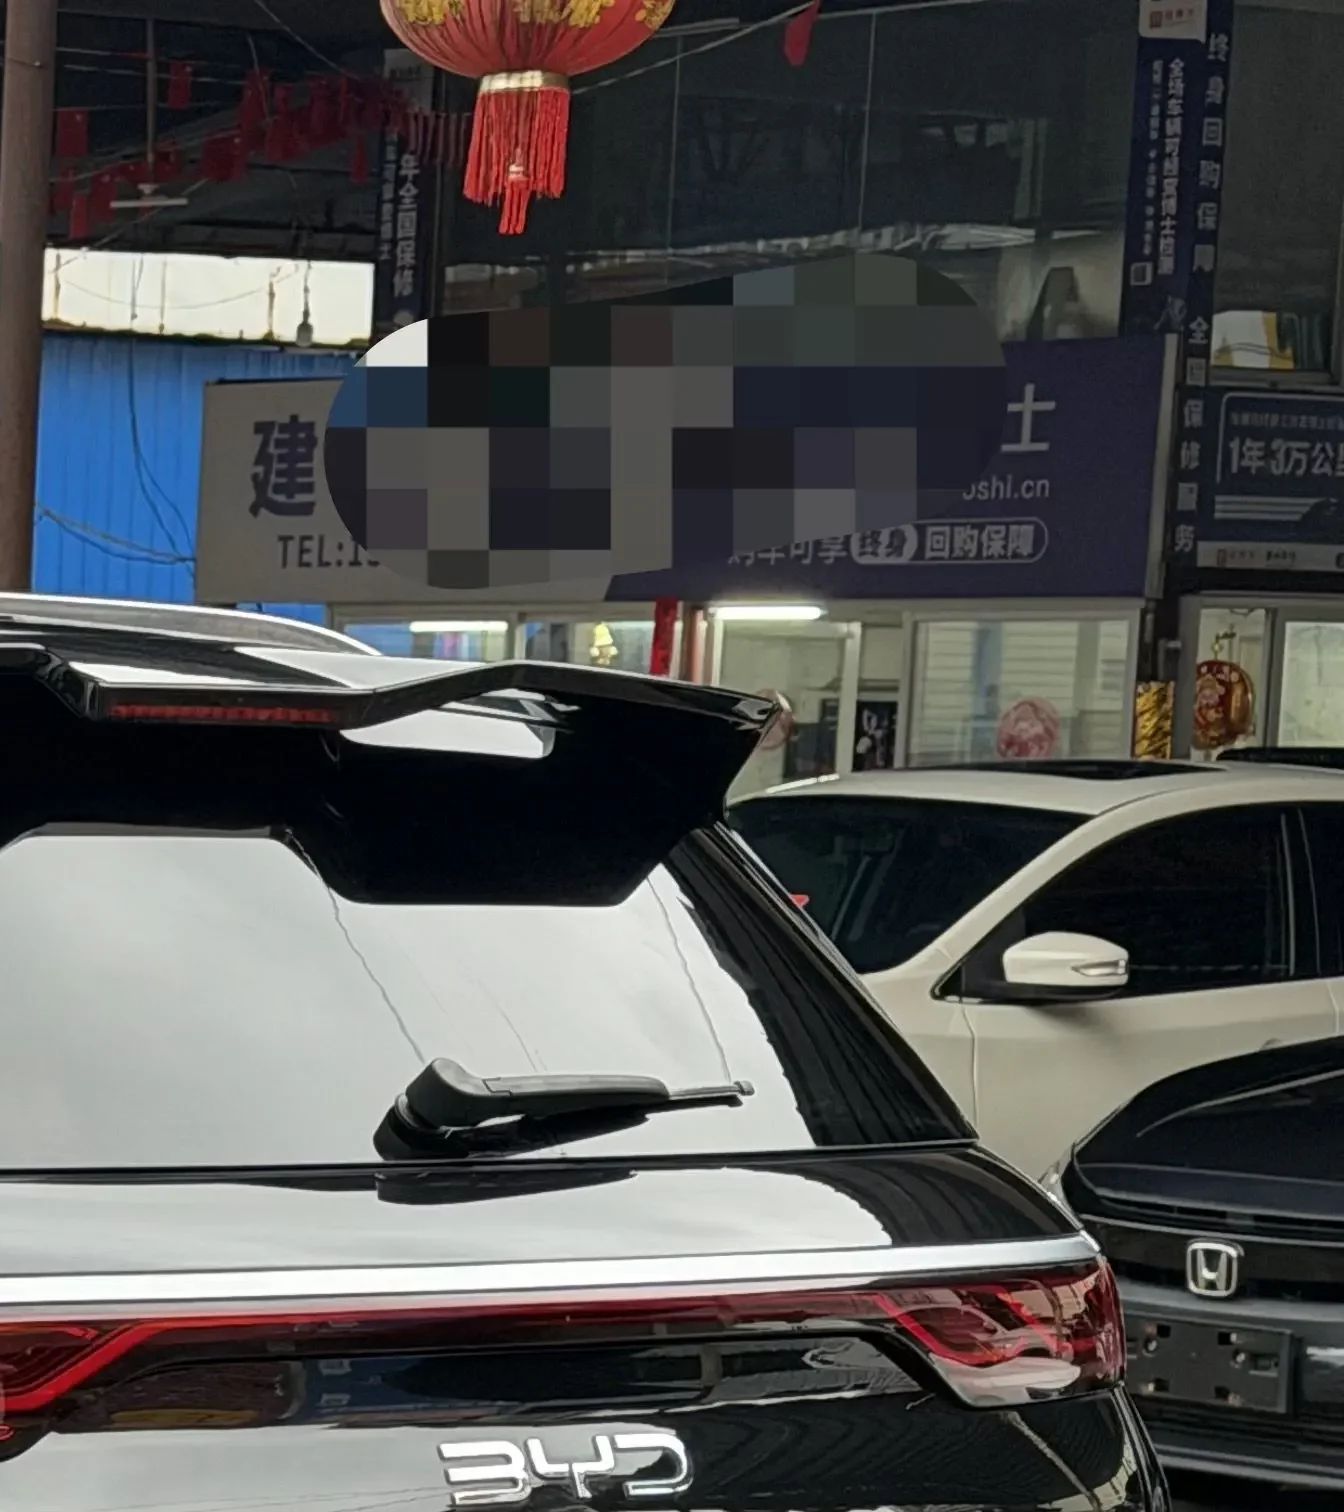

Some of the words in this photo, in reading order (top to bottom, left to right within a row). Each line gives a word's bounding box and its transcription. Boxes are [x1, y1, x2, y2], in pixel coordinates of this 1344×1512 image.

[248, 414, 319, 519] 建
[277, 535, 381, 570] TEL:1
[436, 1431, 695, 1508] BYD
